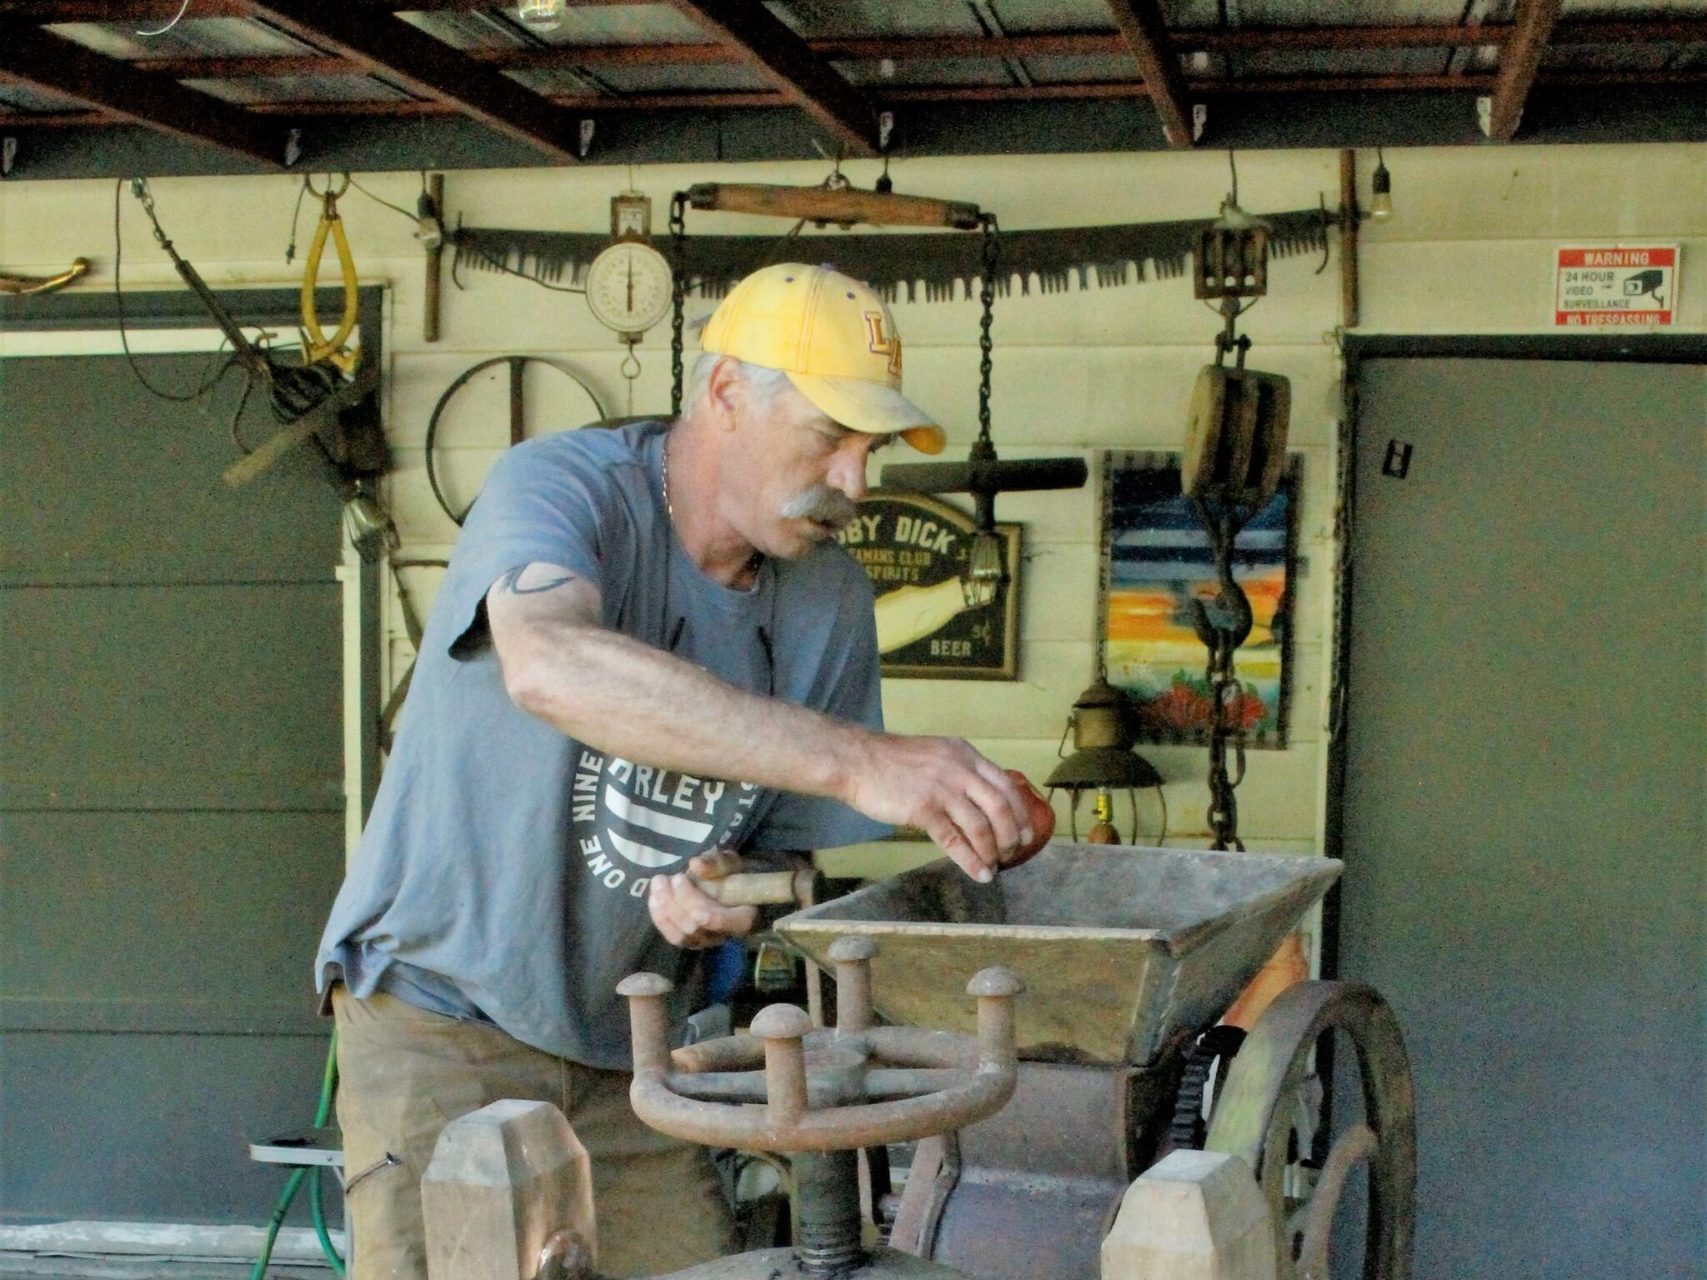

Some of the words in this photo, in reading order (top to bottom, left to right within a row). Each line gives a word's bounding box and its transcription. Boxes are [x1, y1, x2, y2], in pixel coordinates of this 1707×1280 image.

[1585, 251, 1649, 265] WARNING
[1565, 271, 1578, 282] 24
[1581, 271, 1615, 282] HOUR
[1565, 285, 1594, 296] VIDEO
[1563, 299, 1630, 309] SURVEILLANCE
[1566, 313, 1581, 325] NO
[1583, 314, 1660, 326] TRESPASSING
[838, 515, 881, 545] BY
[895, 516, 956, 554] DICK
[931, 640, 971, 656] BEER
[572, 750, 604, 822] NINE
[607, 757, 725, 815] ARLEY
[579, 834, 626, 889] ONE
